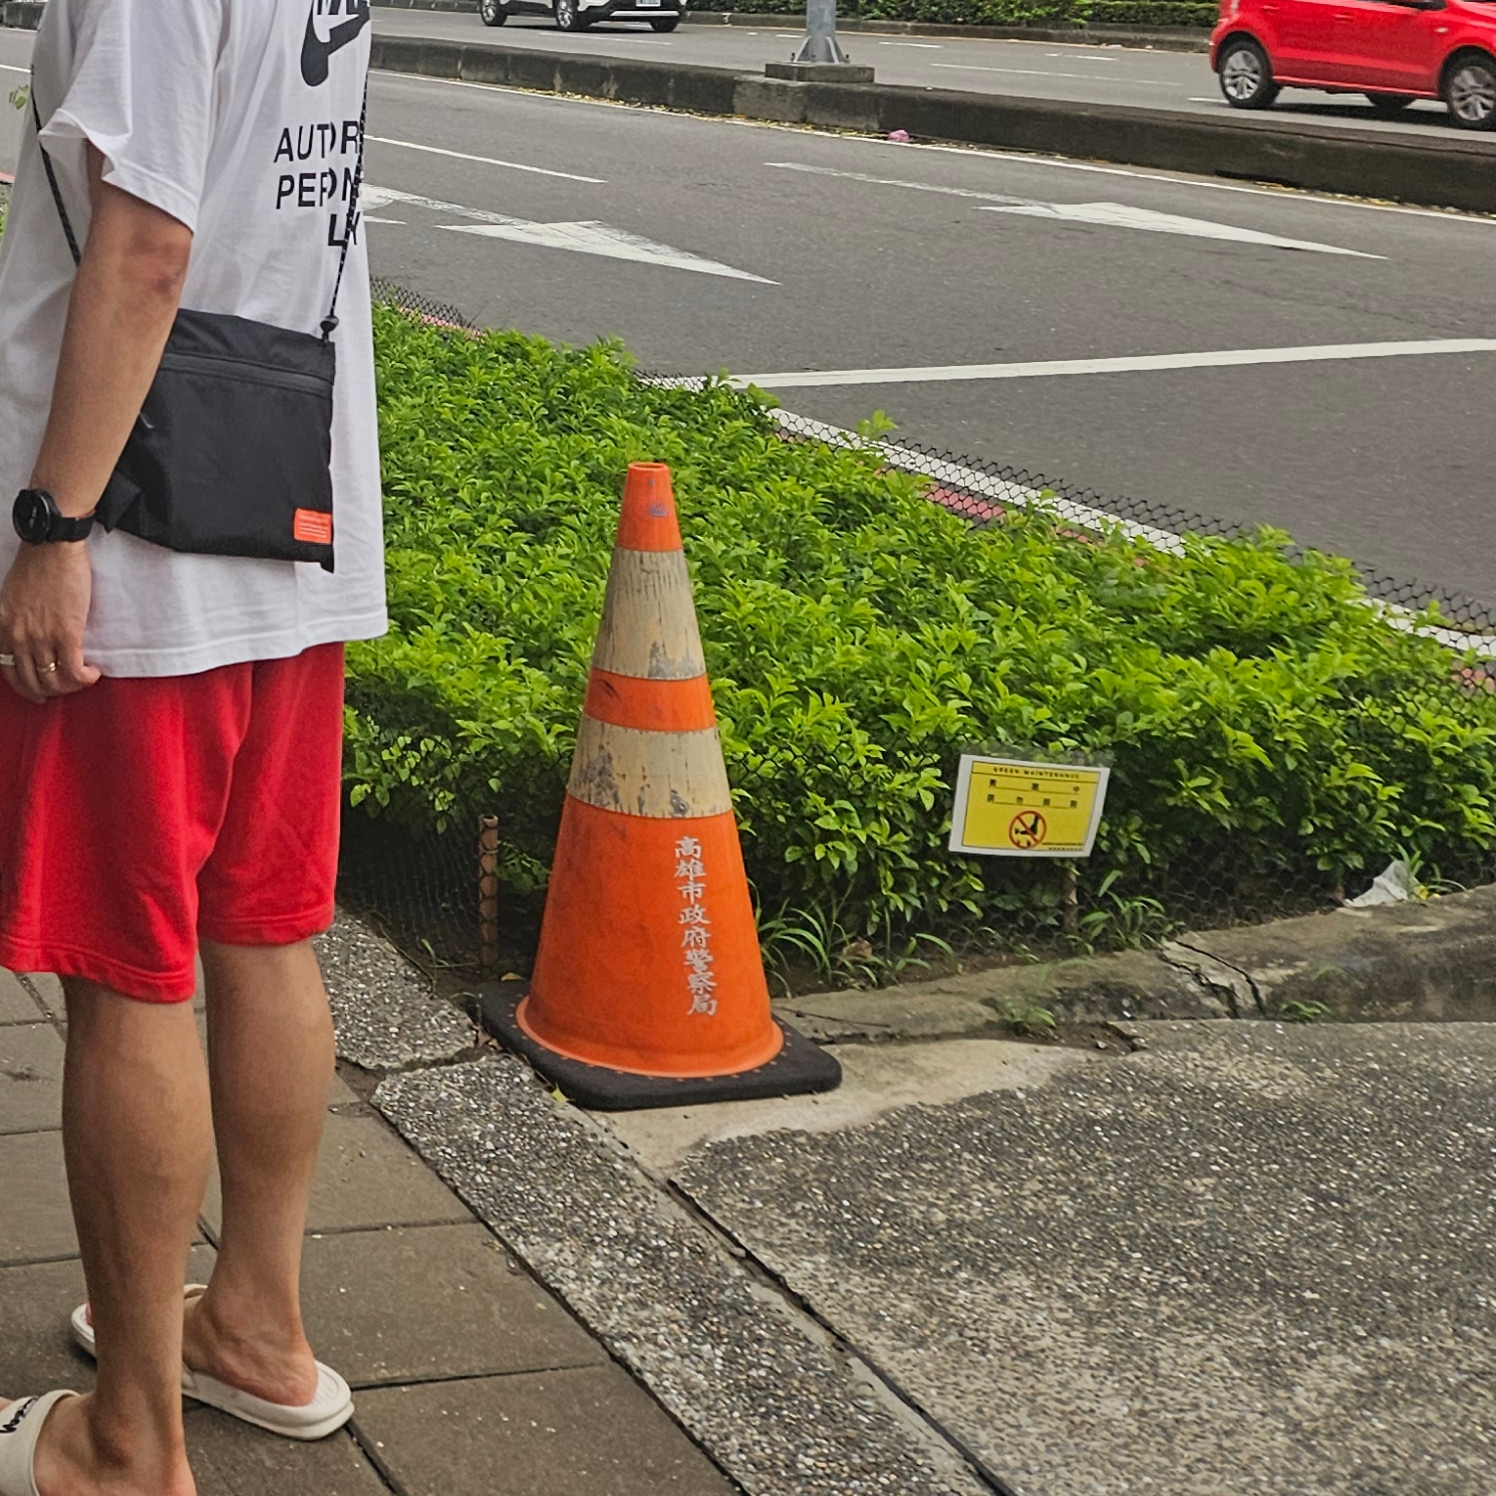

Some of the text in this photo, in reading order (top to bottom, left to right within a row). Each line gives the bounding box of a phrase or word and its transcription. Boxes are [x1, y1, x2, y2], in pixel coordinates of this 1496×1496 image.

[993, 766, 1020, 775] GREEN
[673, 835, 718, 1017] 高雄市政府警察局
